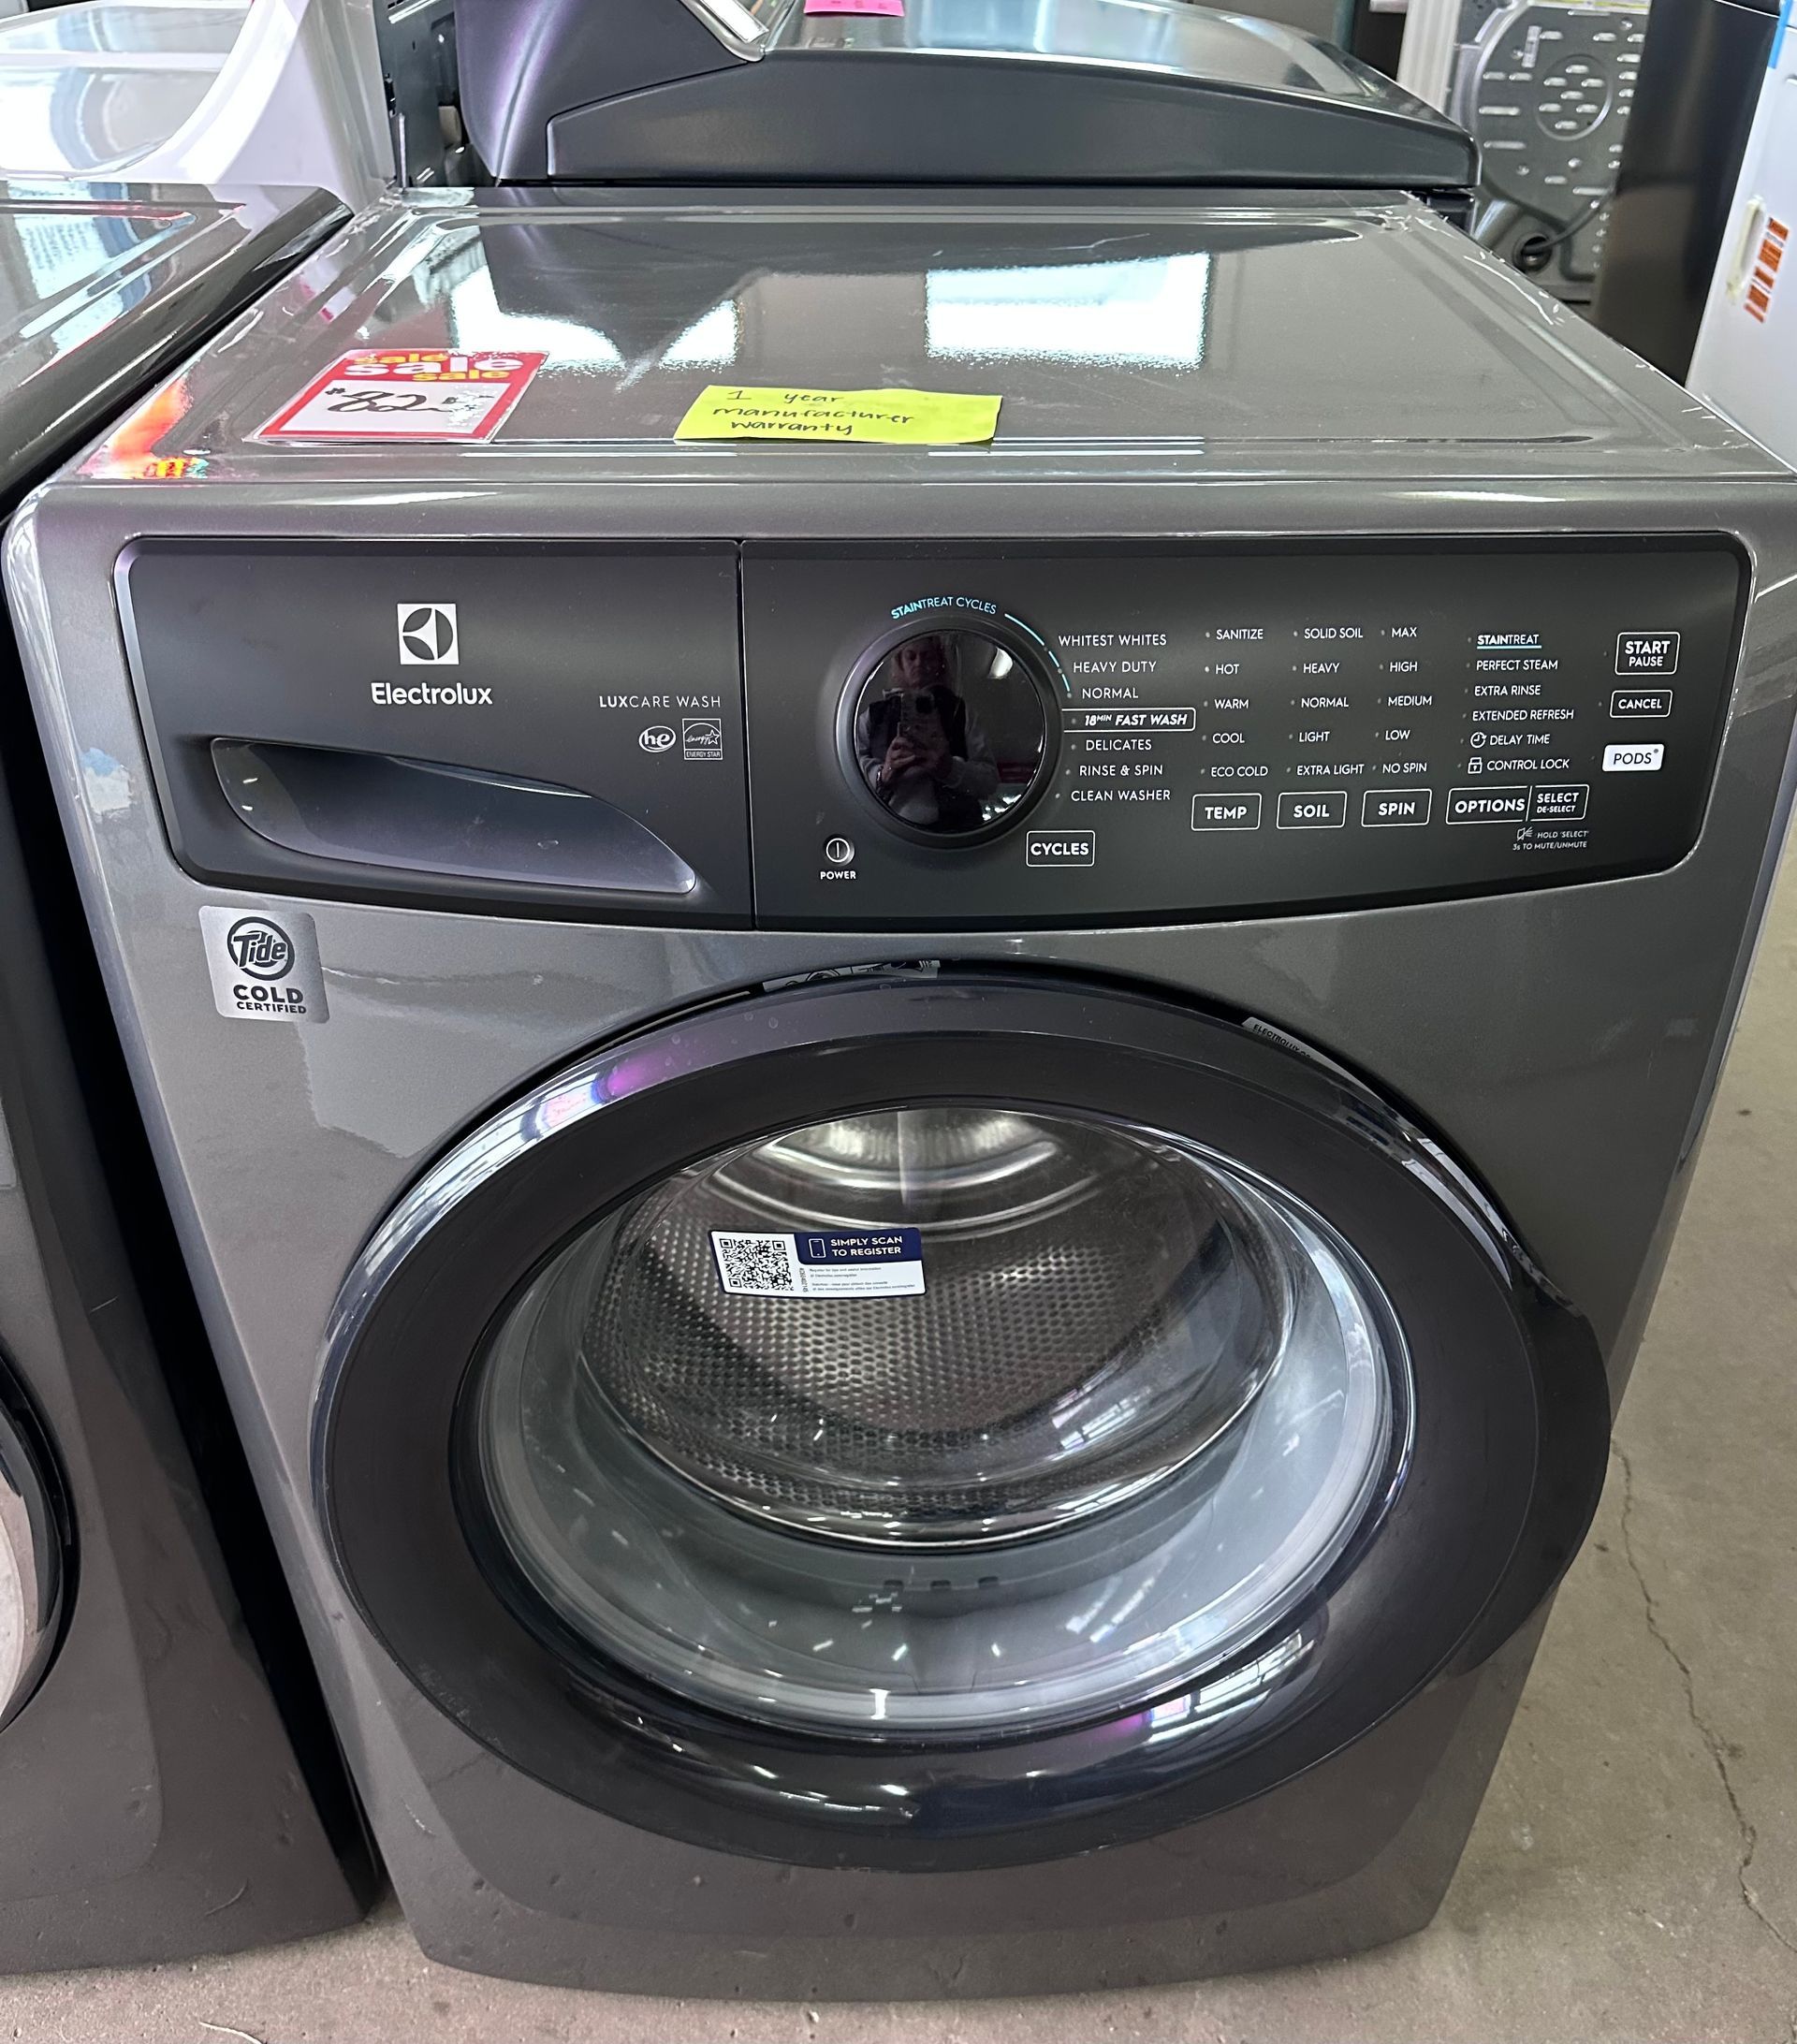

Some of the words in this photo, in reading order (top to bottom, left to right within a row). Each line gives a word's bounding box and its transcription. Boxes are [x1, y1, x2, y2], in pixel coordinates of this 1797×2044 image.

[353, 352, 448, 365] sale
[343, 357, 524, 375] sale
[412, 369, 510, 381] sale
[727, 389, 752, 401] 1
[784, 392, 843, 403] year
[731, 421, 854, 436] warranty
[890, 596, 954, 620] STAINTREAT
[956, 596, 998, 615] CYCLES
[1216, 628, 1264, 640] SANITIZE
[1304, 628, 1337, 639] SOLID
[1339, 627, 1364, 638] SOIL
[1391, 627, 1418, 637] MAX
[1059, 635, 1115, 647] WHITEST
[1118, 634, 1168, 646] WHITES
[1477, 634, 1540, 646] STAINTREAT
[1625, 640, 1671, 654] START
[1074, 662, 1118, 673] HEAVY
[1121, 661, 1157, 672] DUTY
[1389, 662, 1418, 673] HIGH
[1476, 660, 1521, 671] PERFECT
[1523, 659, 1558, 670] STEAM
[1629, 656, 1663, 667] PAUSE
[1215, 664, 1240, 675] HOT
[1303, 663, 1340, 674] HEAVY
[371, 682, 493, 706] Electrolux
[1082, 688, 1139, 699] NORMAL
[1474, 685, 1508, 696] EXTRA
[1511, 684, 1541, 695] RINSE
[599, 695, 670, 708] LUXCARE
[677, 695, 722, 708] WASH
[1214, 698, 1249, 709] WARM
[1301, 697, 1349, 708] NORMAL
[1387, 695, 1433, 707] MEDIUM
[1618, 698, 1662, 709] CANCEL
[1115, 714, 1147, 726] FAST
[1150, 713, 1188, 725] WASH
[1472, 710, 1527, 722] EXTENDED
[1530, 709, 1574, 721] REFRESH
[1212, 733, 1245, 744] COOL
[1298, 731, 1331, 742] LIGHT
[1385, 730, 1410, 741] LOW
[1489, 735, 1523, 746] DELAY
[1527, 734, 1550, 745] TIME
[1086, 739, 1152, 751] DELICATES
[1486, 760, 1538, 771] CONTROL
[1541, 758, 1571, 769] LOCK
[1613, 752, 1652, 765] PODS
[1079, 766, 1116, 777] RINSE
[1120, 766, 1131, 776] &
[1134, 765, 1163, 776] SPIN
[1210, 766, 1235, 778] ECO
[1236, 766, 1268, 778] COLD
[1296, 765, 1331, 776] EXTRA
[1334, 764, 1365, 775] LIGHT
[1381, 763, 1400, 774] NO
[1403, 763, 1427, 774] SPIN
[1071, 790, 1113, 802] CLEAN
[1118, 789, 1171, 801] WASHER
[1536, 792, 1580, 804] SELECT
[1293, 804, 1330, 818] SOIL
[1378, 802, 1416, 816] SPIN
[1454, 798, 1526, 814] OPTIONS
[1536, 805, 1576, 814] DE-SELECT
[1205, 806, 1248, 820] TEMP
[1537, 831, 1558, 840] HOLD
[1030, 841, 1090, 855] CYCLES
[1535, 840, 1587, 850] MUTE/UNMUTE
[820, 870, 856, 880] POWER
[232, 932, 287, 968] Tide
[233, 984, 303, 1004] COLD
[236, 1001, 307, 1015] CERTIFIED
[830, 1237, 869, 1248] SIMPLY
[871, 1235, 903, 1246] SCAN
[831, 1248, 848, 1257] TO
[851, 1247, 902, 1256] REGISTER
